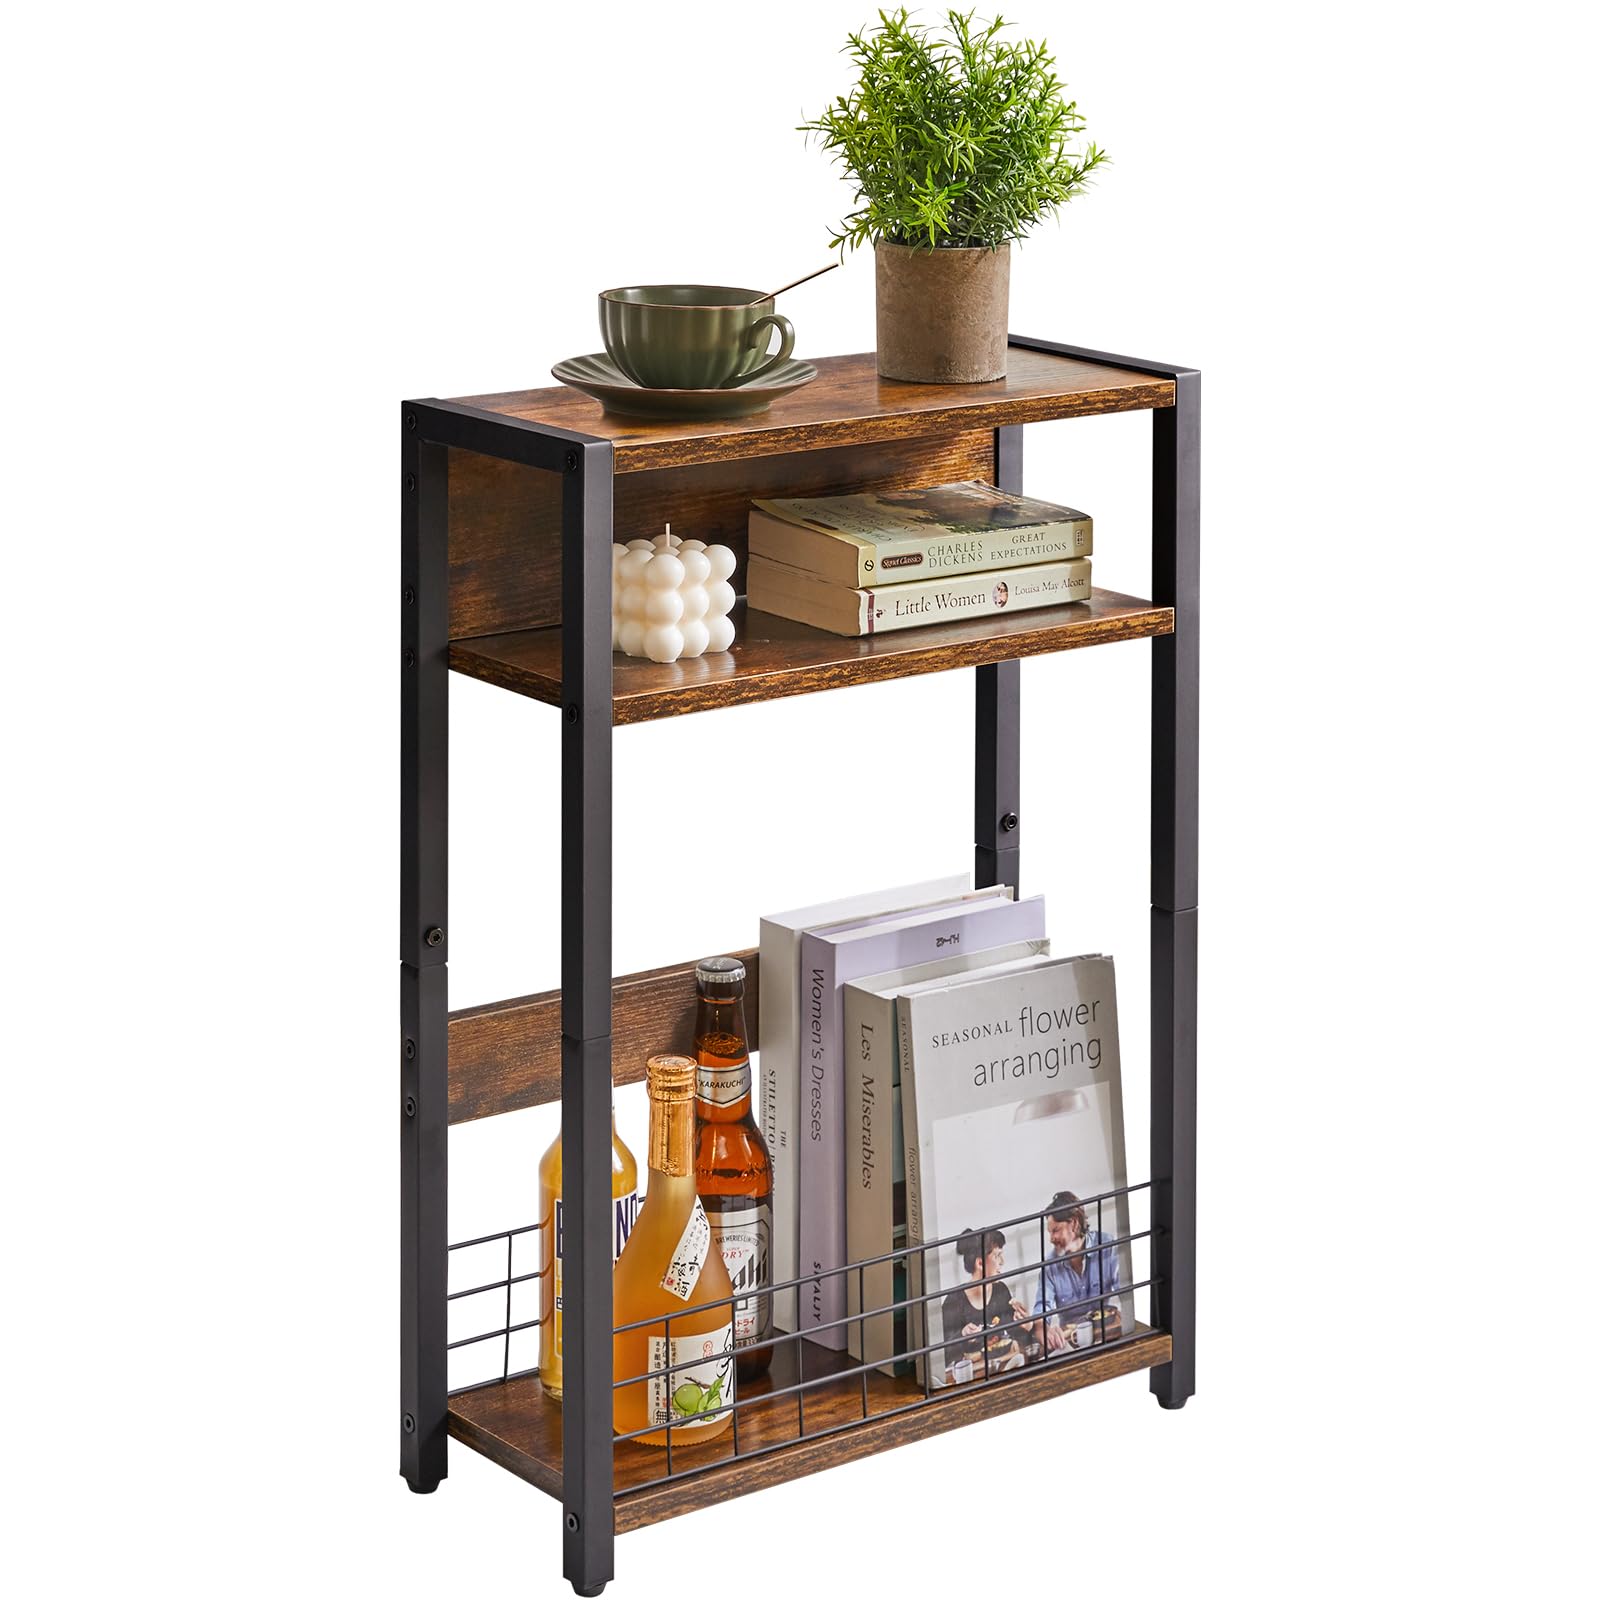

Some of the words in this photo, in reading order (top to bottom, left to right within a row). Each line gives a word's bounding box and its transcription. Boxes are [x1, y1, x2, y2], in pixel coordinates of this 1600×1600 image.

[927, 540, 983, 557] CHARLES
[990, 542, 1067, 560] EXPECTATIONS
[1011, 532, 1045, 544] GREAT
[900, 555, 922, 565] Classics
[928, 551, 983, 568] DICKENS
[895, 596, 932, 616] Little
[934, 592, 986, 610] Women
[1014, 585, 1040, 596] Louisa
[1042, 581, 1059, 594] May
[1061, 578, 1085, 589] Alcott
[811, 968, 825, 1060] Women's
[931, 1020, 1013, 1049] SEASONAL
[1019, 1000, 1101, 1038] flower
[861, 1020, 874, 1061] Les
[973, 1037, 1102, 1087] arranging
[767, 1068, 776, 1144] STILETTO
[811, 1065, 825, 1142] Dresses
[861, 1073, 875, 1190] Miserables
[908, 1147, 918, 1185] flower
[910, 1191, 920, 1253] arrangin
[720, 1250, 744, 1259] DRY
